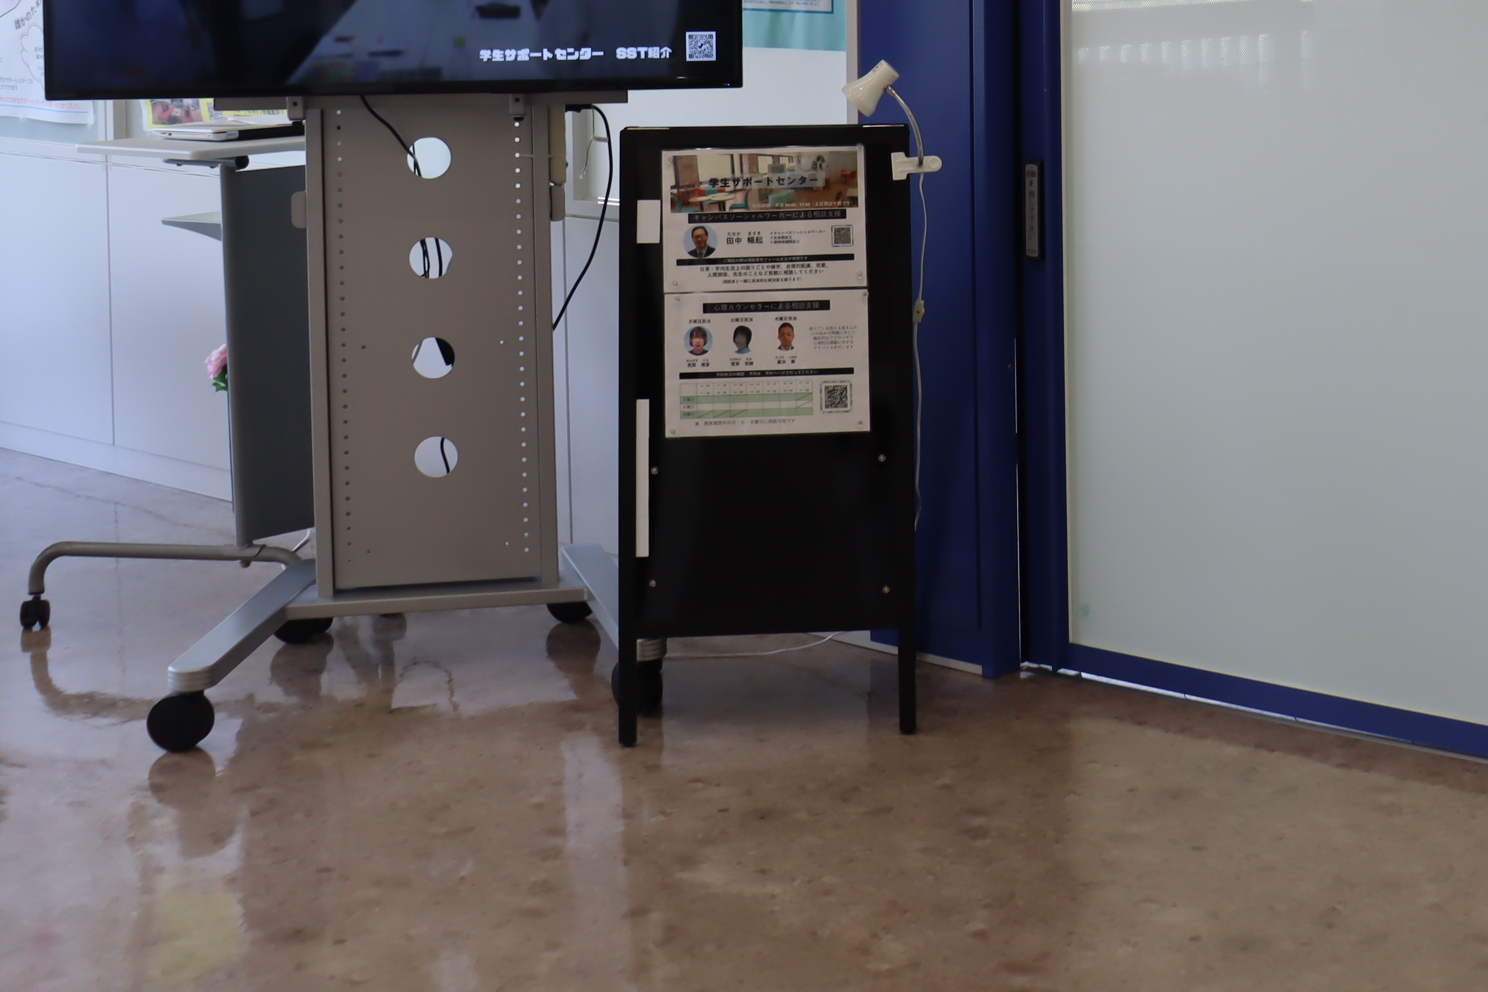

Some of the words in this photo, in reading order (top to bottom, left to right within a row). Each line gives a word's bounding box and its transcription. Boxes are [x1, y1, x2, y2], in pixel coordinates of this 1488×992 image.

[479, 47, 604, 62] 学生サポートセンター
[615, 46, 673, 60] SST紹介
[708, 176, 818, 188] 学生サポートセンター
[726, 237, 742, 245] 田中
